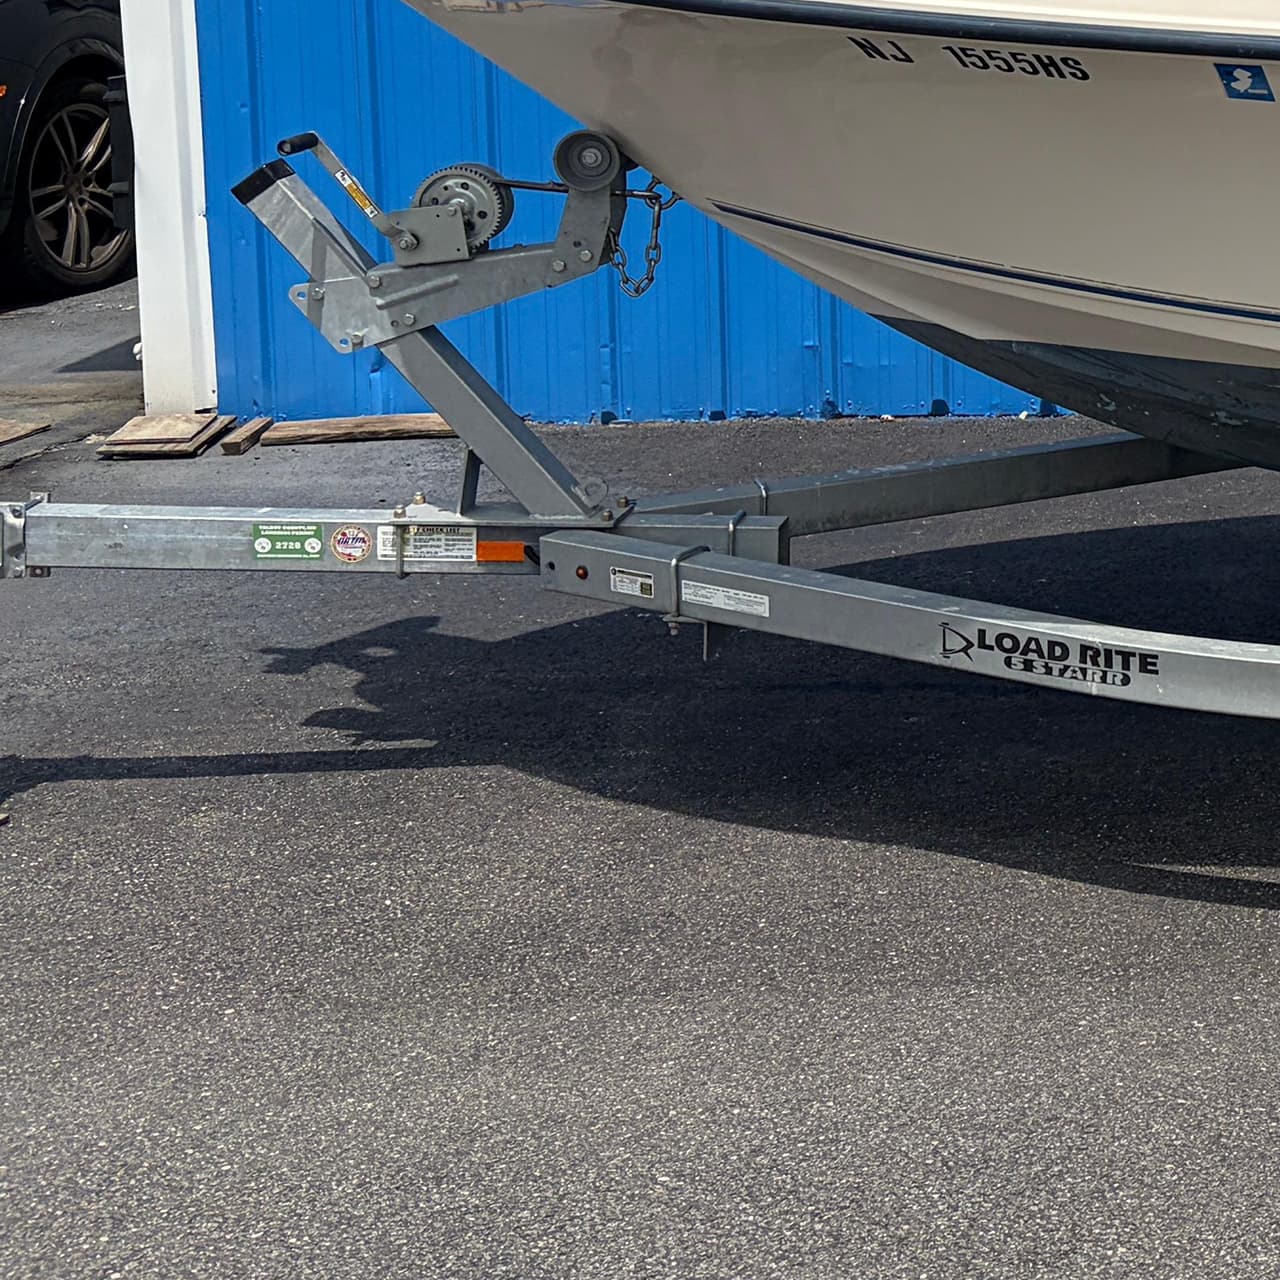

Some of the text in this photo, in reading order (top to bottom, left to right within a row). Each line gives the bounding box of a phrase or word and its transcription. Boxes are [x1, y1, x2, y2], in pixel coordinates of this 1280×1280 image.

[847, 36, 1090, 81] NJ 1555HS
[976, 628, 1160, 675] LOAD RITE
[1010, 657, 1125, 687] 5 STARR
